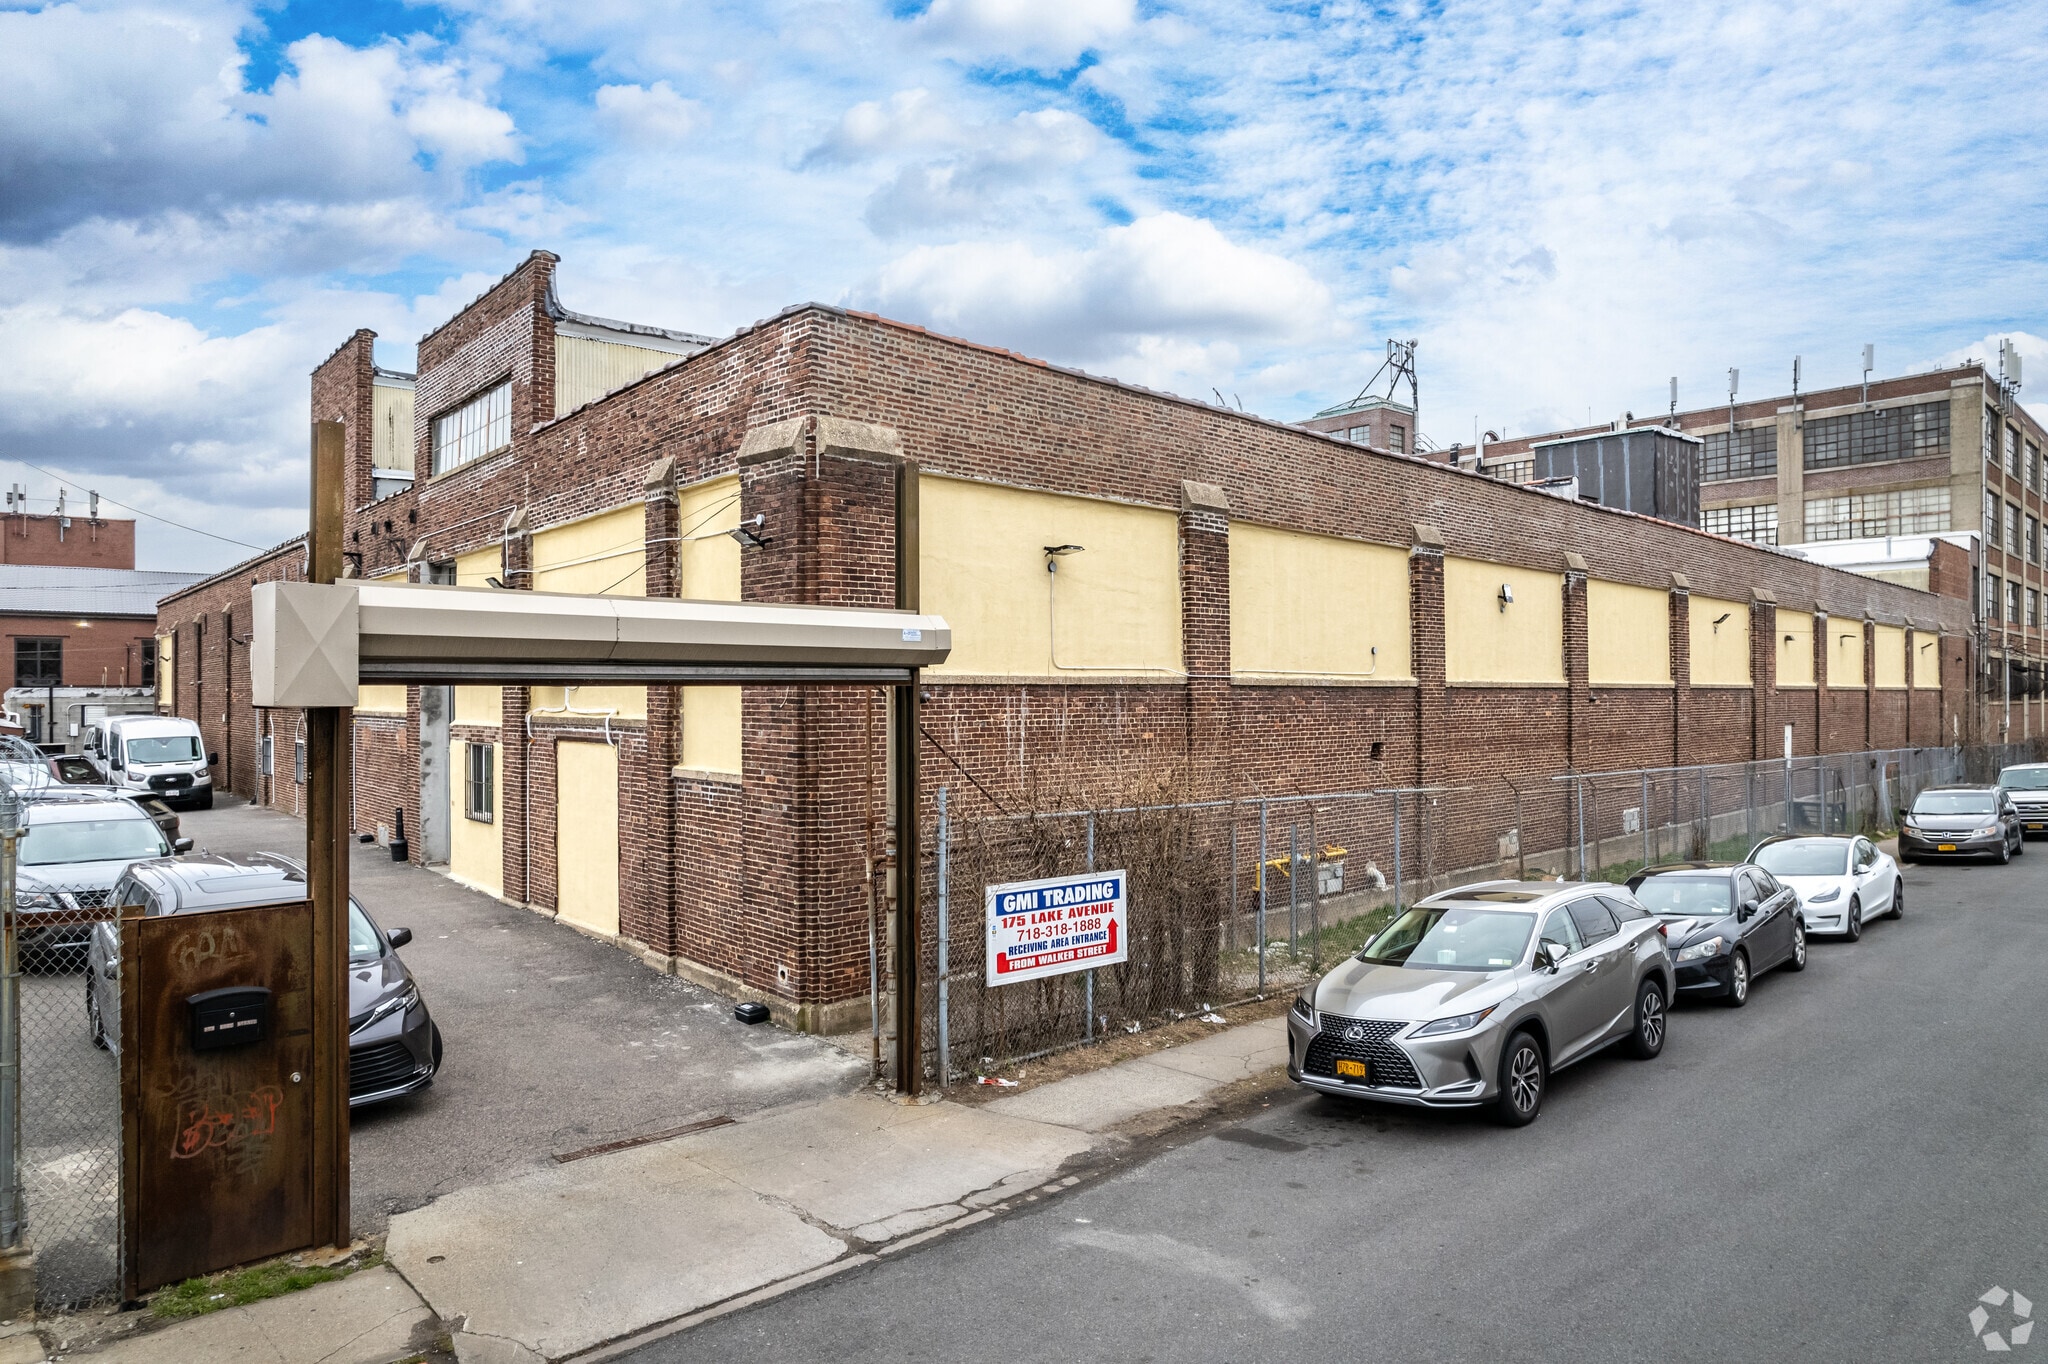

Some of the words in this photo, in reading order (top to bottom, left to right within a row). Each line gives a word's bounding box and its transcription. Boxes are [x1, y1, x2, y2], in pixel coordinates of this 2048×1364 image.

[1003, 892, 1038, 912] GMI
[1043, 882, 1114, 906] TRADING
[1001, 914, 1026, 929] 175
[1031, 909, 1063, 925] LAKE
[1068, 901, 1115, 918] AVENUE
[1008, 940, 1048, 957] RECEIVING
[1050, 936, 1070, 949] AREA
[1071, 930, 1107, 946] ENTRANCE
[1017, 918, 1101, 942] 718-318-1888
[1009, 956, 1036, 970] FROM
[1038, 949, 1075, 965] WALKER
[1076, 944, 1107, 958] STREET
